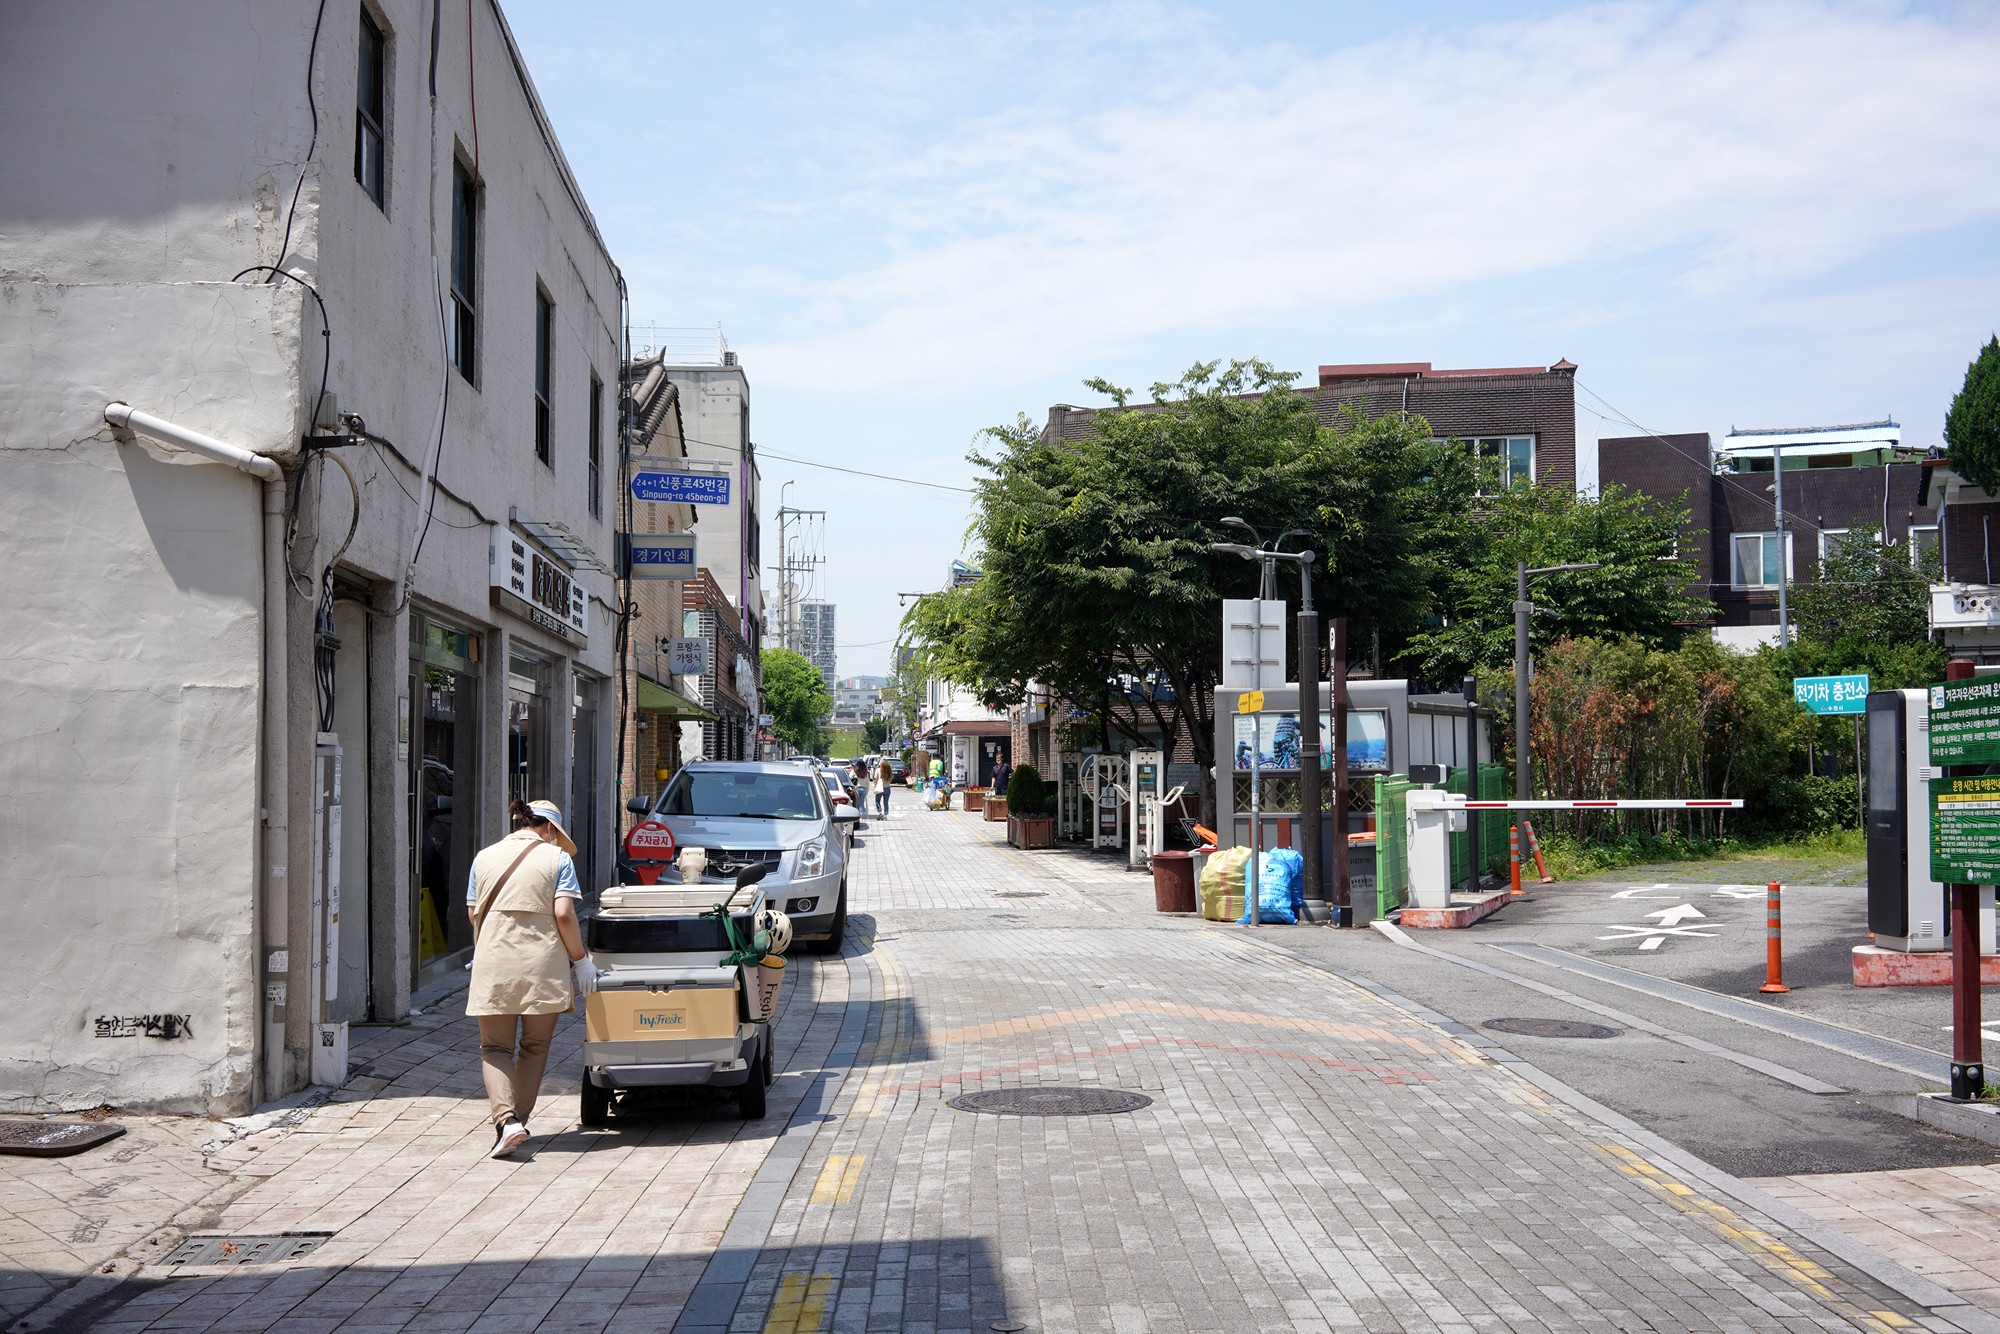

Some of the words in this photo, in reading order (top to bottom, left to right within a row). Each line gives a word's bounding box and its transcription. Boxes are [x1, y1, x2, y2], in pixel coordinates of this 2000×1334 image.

[659, 476, 727, 493] 신풍로45번길
[642, 489, 683, 501] Sinpung-ro
[685, 492, 726, 503] 45beon-gil
[636, 549, 690, 563] 경기인쇄
[676, 641, 702, 652] 프랑스
[676, 652, 702, 664] 가정식
[1796, 683, 1830, 703] 전기차
[1832, 681, 1867, 702] 충전소
[1945, 684, 1992, 702] 거주자우선주차제
[1992, 682, 2000, 697] 운
[1953, 780, 1963, 792] 운영
[1963, 780, 1974, 791] 시간
[1974, 780, 1980, 791] 및
